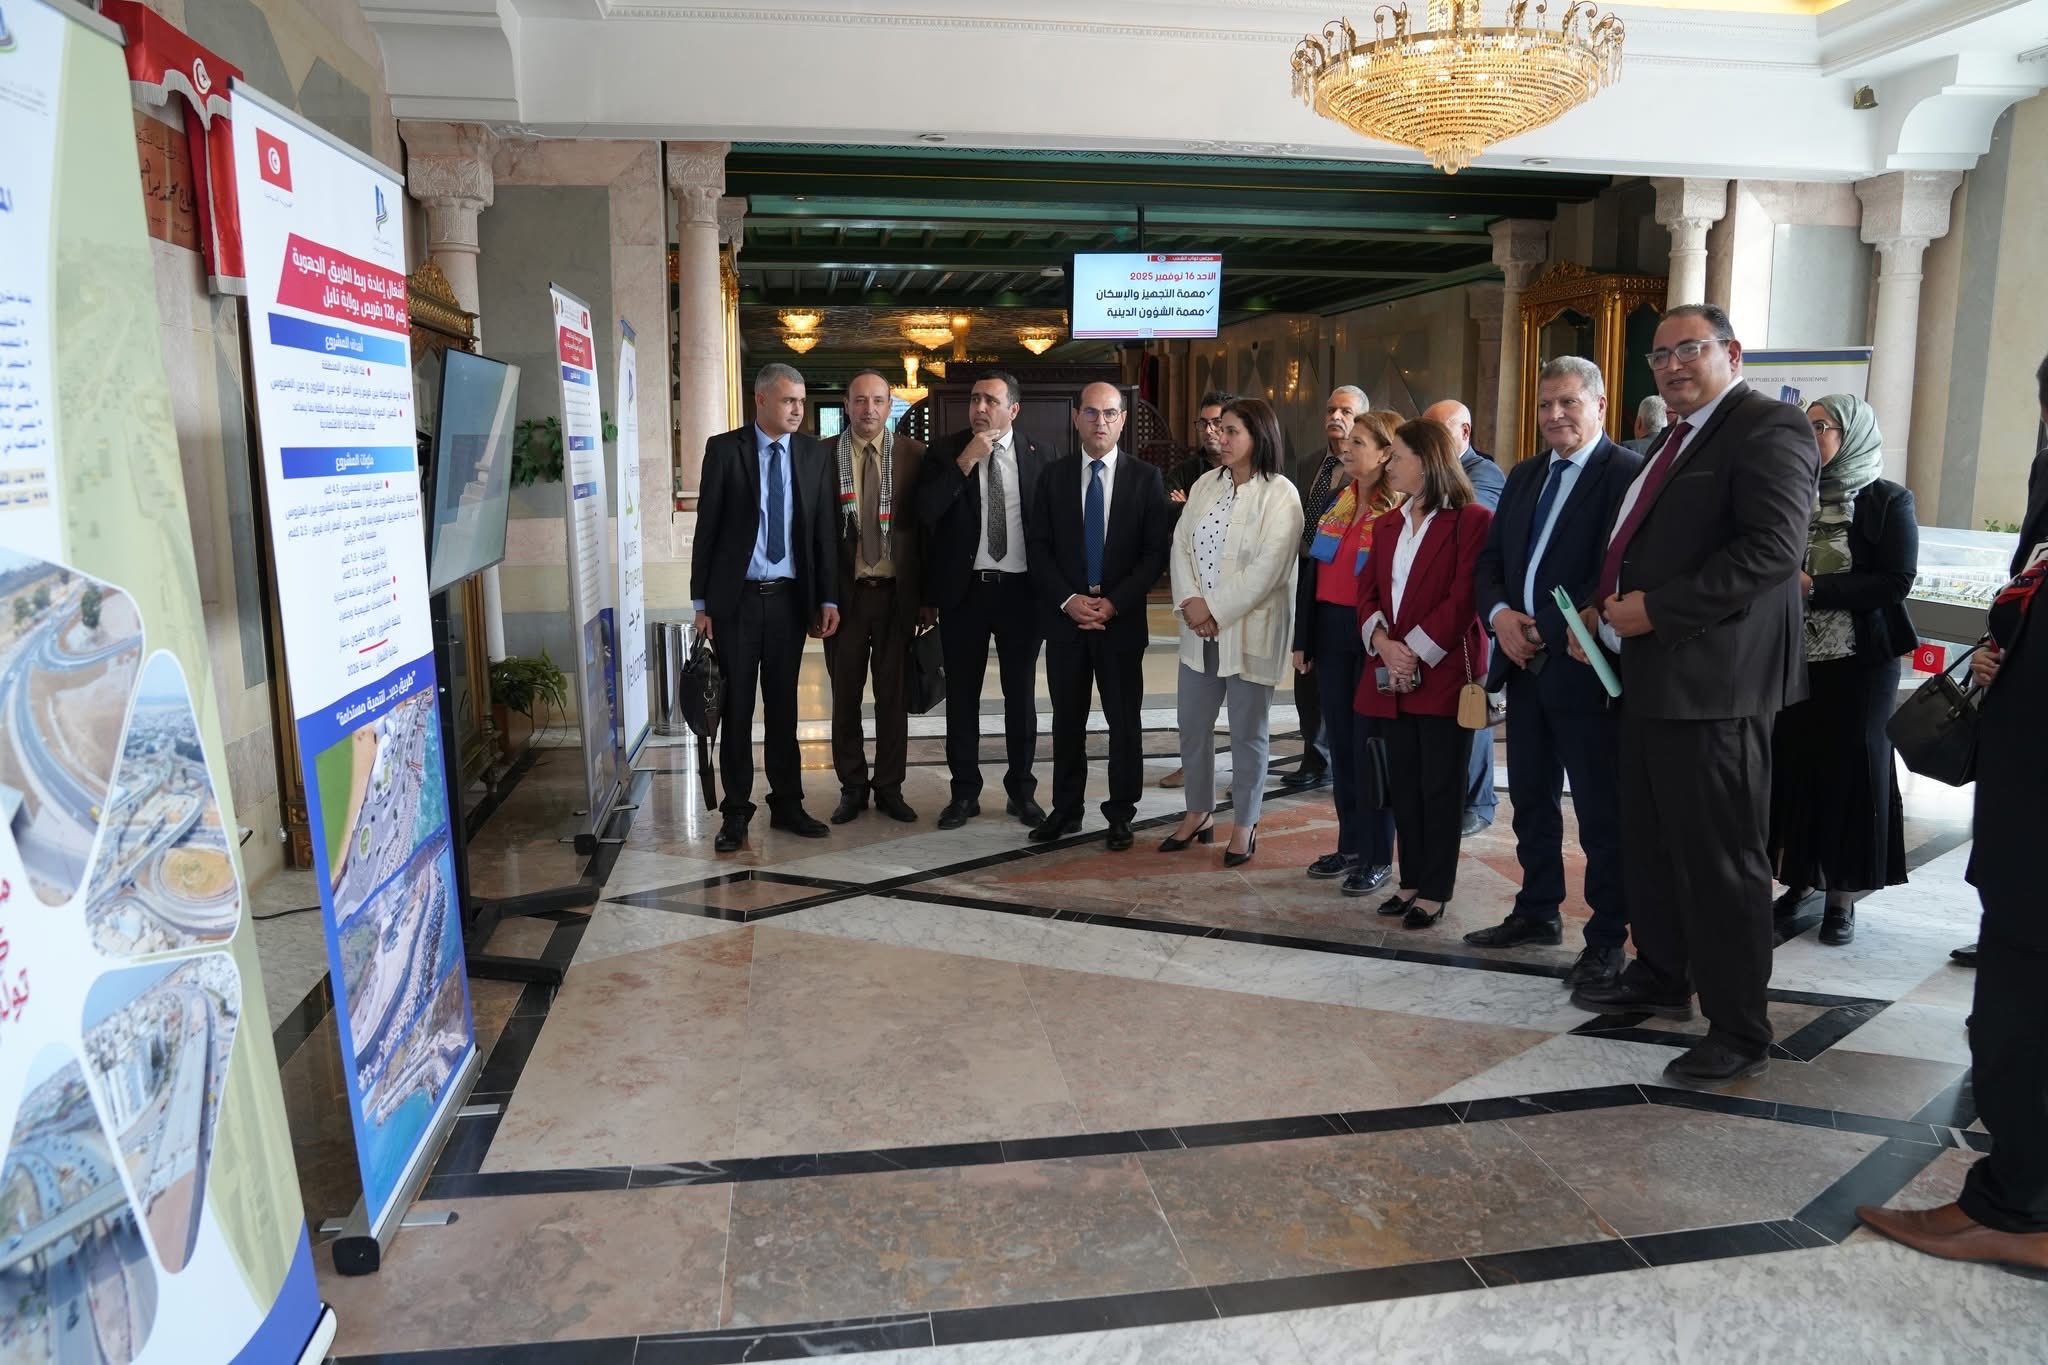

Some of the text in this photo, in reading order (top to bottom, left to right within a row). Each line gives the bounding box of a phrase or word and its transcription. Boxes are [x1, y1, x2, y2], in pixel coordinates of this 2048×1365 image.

[292, 248, 404, 300] أشغال إعادة ربط الطريق الجهوية
[1130, 272, 1153, 280] 2025
[1155, 272, 1183, 281] نوفمبر
[1186, 272, 1195, 280] 16
[323, 286, 339, 308] نابل
[341, 291, 359, 316] بولاية
[1096, 288, 1205, 301] مهمة التجهيز والإسكان
[384, 304, 394, 320] 128
[396, 308, 406, 328] رقم
[1107, 305, 1205, 318] مهمة الشؤون الدينية
[325, 333, 349, 351] المشروع
[336, 452, 359, 472] المشروع
[367, 689, 386, 712] لتنمية
